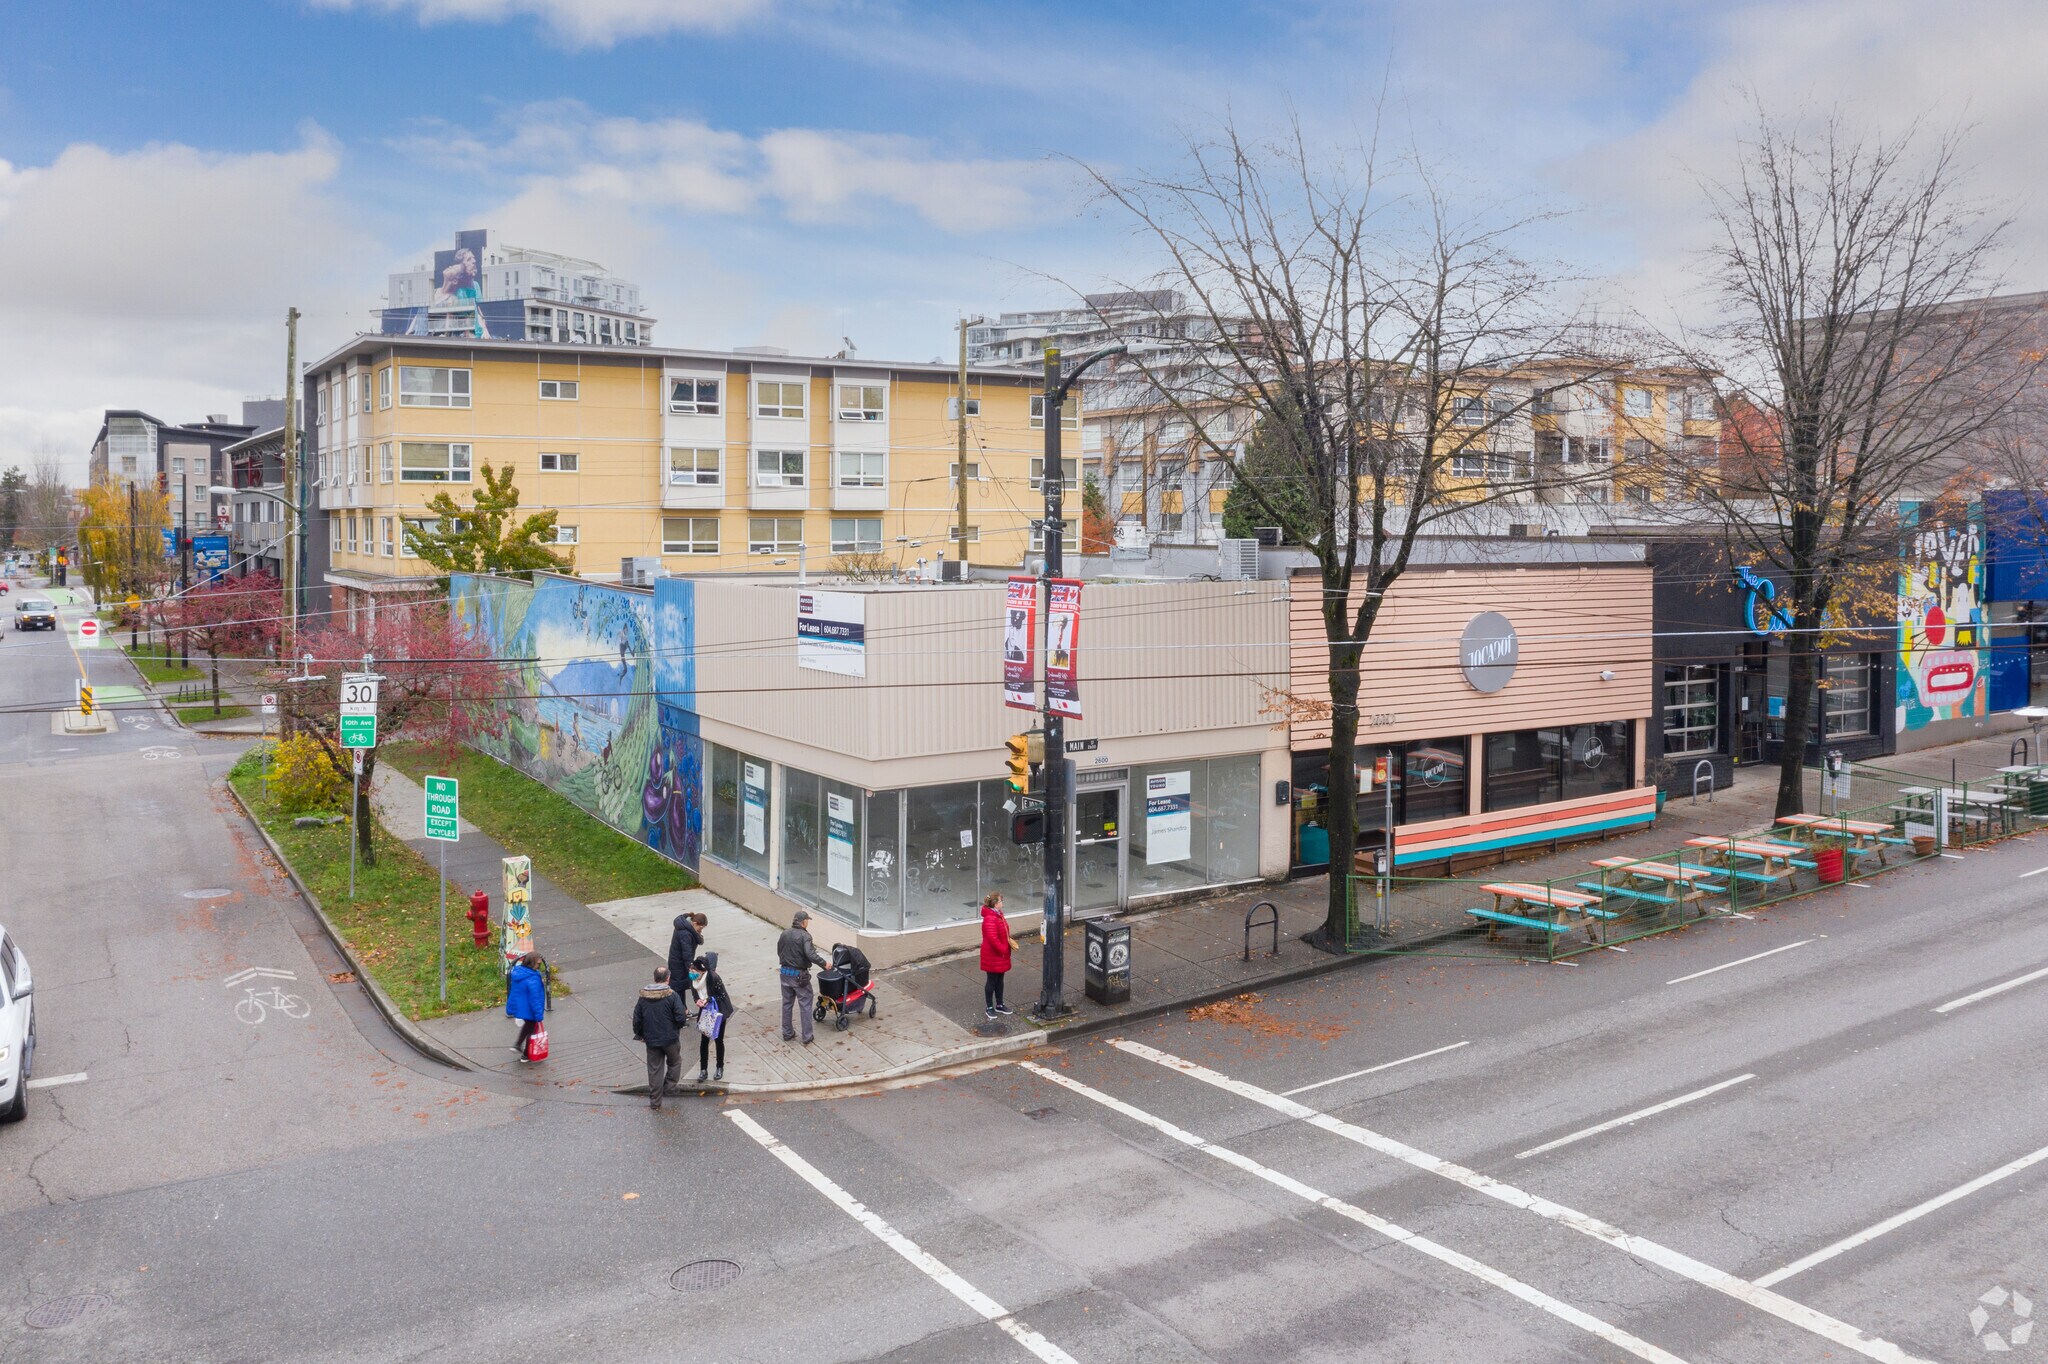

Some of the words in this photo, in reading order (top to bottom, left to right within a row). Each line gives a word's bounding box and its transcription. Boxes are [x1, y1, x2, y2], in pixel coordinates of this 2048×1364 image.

[799, 622, 807, 631] For
[807, 623, 820, 633] Lease
[347, 685, 372, 703] 30
[1069, 742, 1084, 751] MAIN
[436, 782, 446, 791] NO
[427, 792, 456, 804] THROUGH
[432, 805, 450, 815] ROAD
[1148, 804, 1178, 813] 604.687.7331
[430, 818, 452, 827] EXCEPT
[428, 828, 456, 837] BICYCLES
